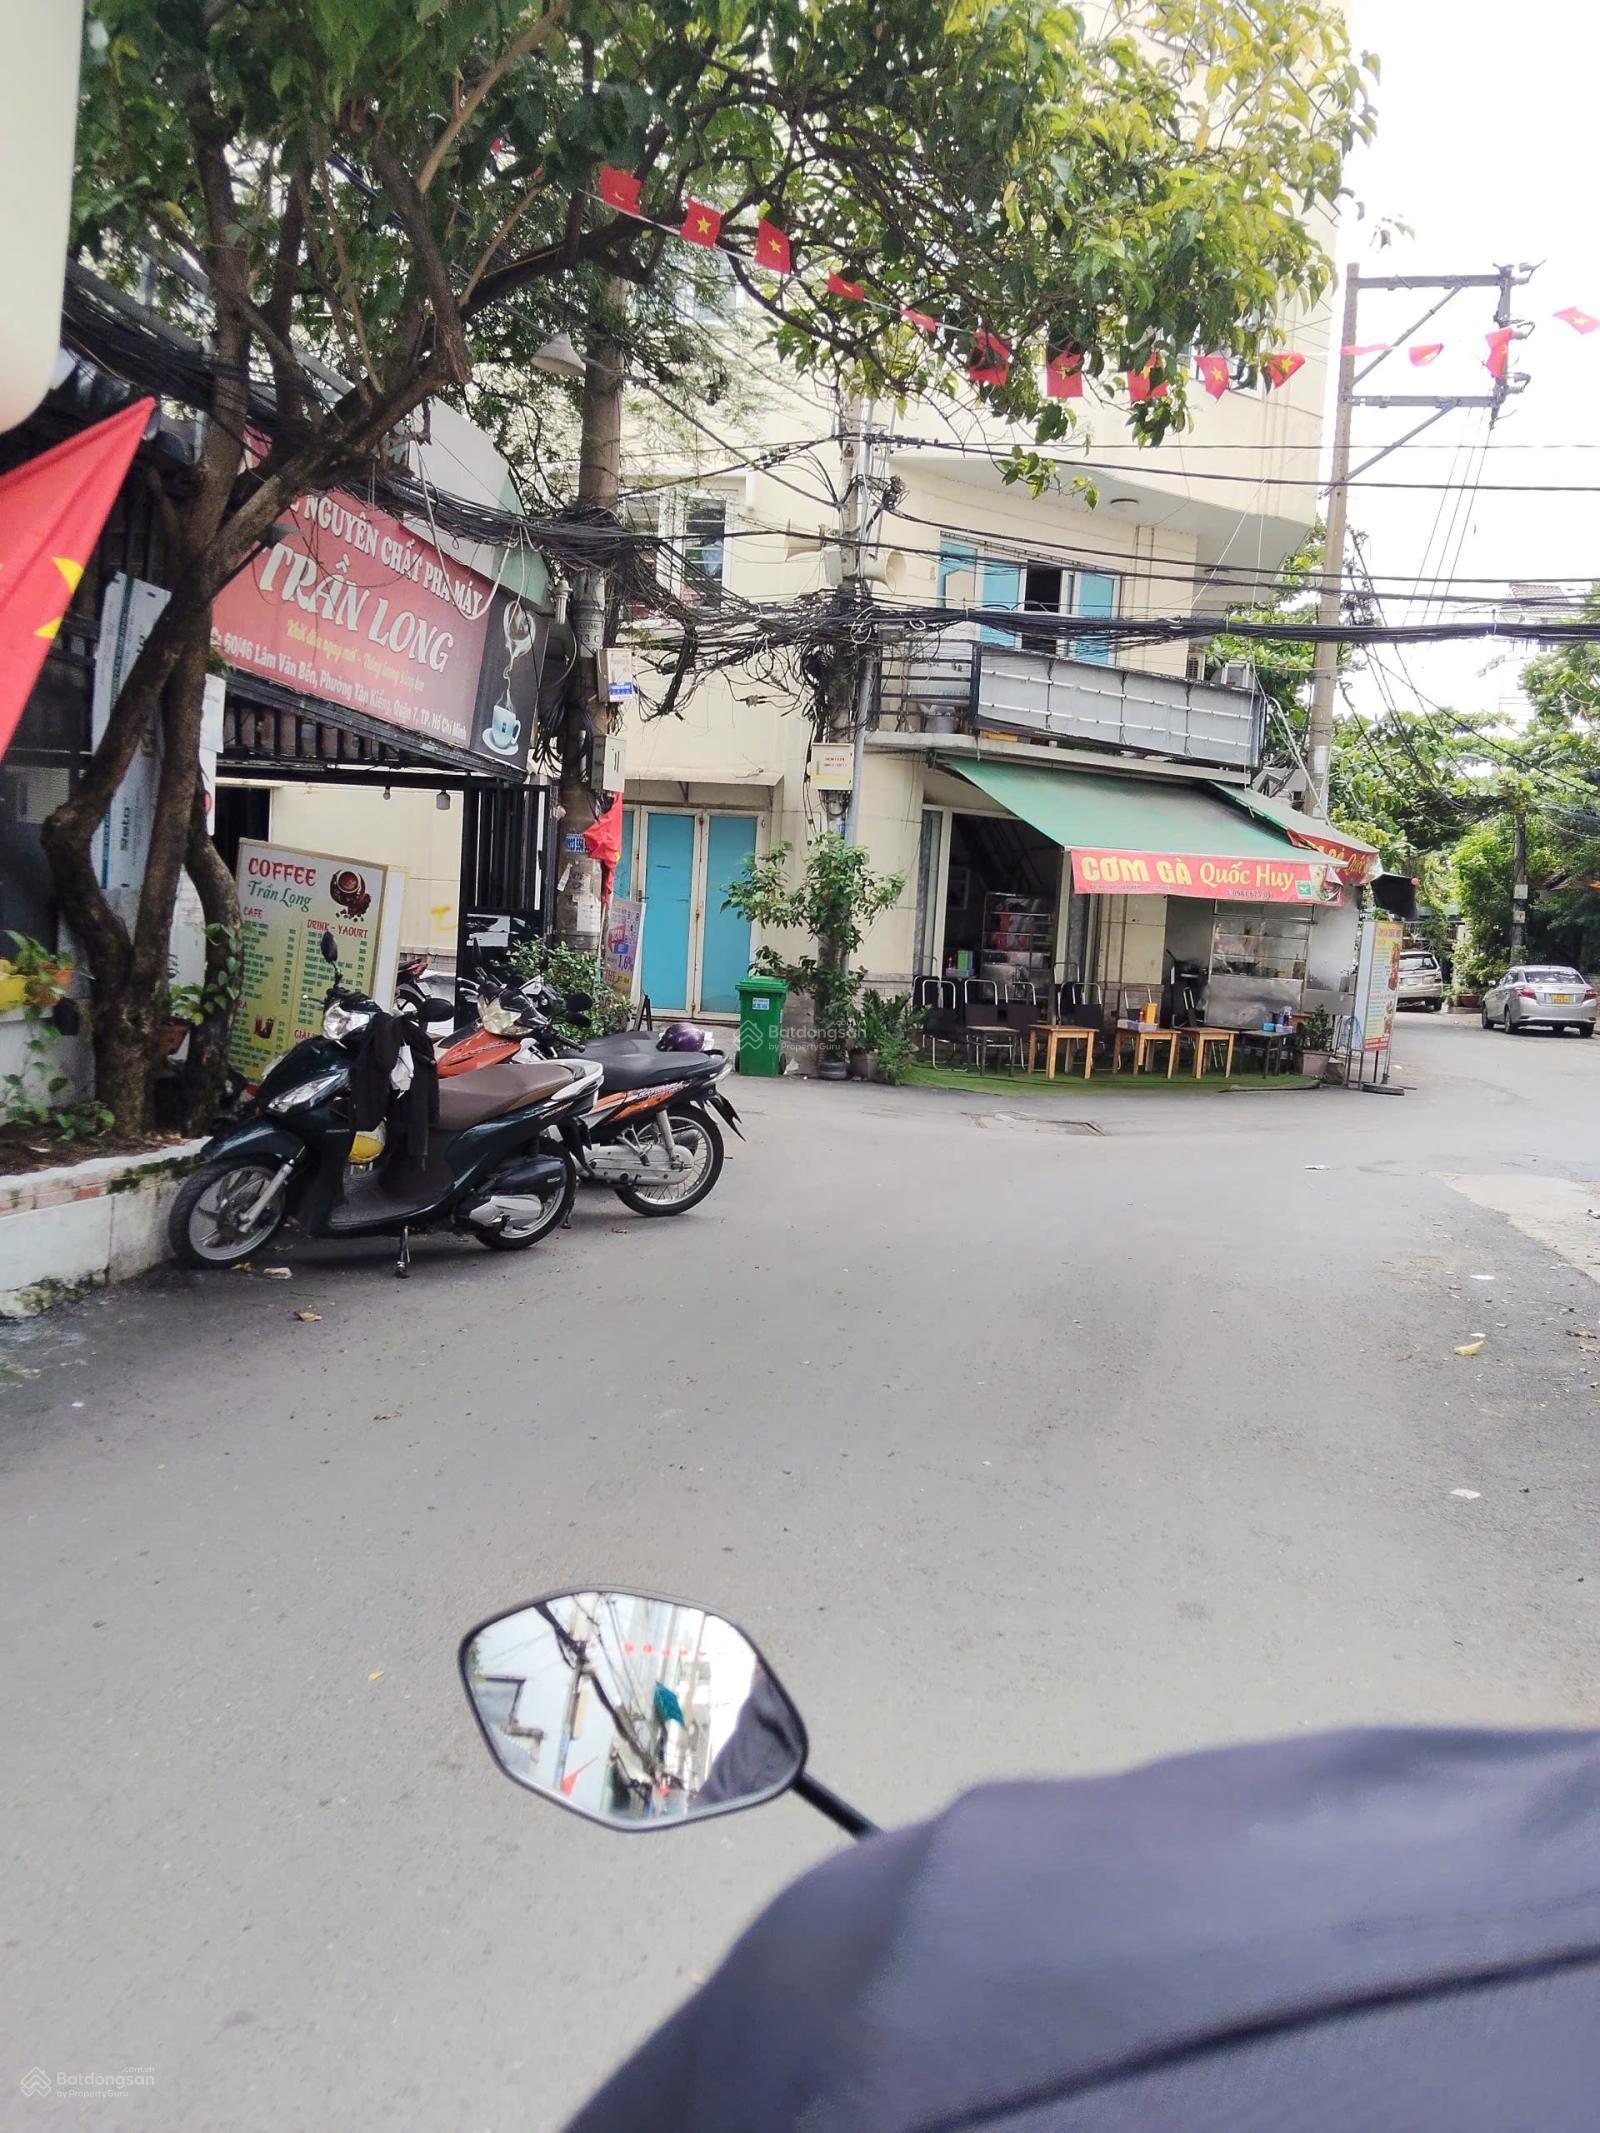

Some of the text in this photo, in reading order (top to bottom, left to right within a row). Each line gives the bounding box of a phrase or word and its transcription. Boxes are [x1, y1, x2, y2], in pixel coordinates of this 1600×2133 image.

[303, 494, 379, 557] NGUYÊN
[380, 536, 422, 583] CHẤT
[452, 580, 483, 617] MÁY
[260, 543, 454, 673] TRẦN LONG
[224, 632, 254, 660] 60/46
[248, 857, 317, 888] COFFEE
[1080, 855, 1294, 893] CƠM GÀ Quốc Huy
[306, 919, 330, 933] DRINK
[338, 924, 369, 939] YAOURT
